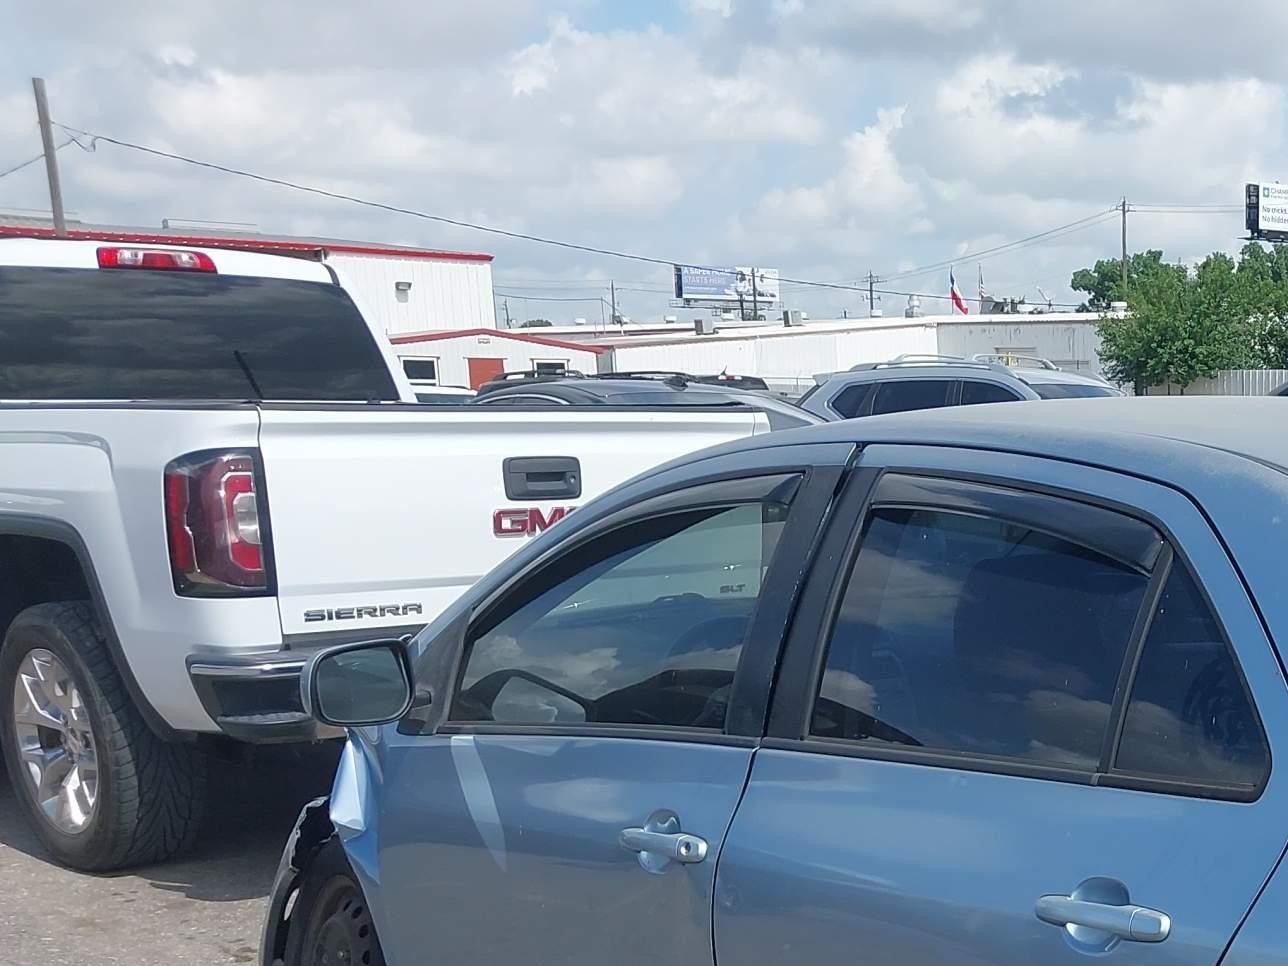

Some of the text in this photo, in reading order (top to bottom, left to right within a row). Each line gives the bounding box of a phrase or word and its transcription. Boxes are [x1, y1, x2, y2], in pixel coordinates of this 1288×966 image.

[1262, 205, 1271, 214] No
[1262, 215, 1271, 223] No
[493, 506, 577, 538] GM
[720, 584, 746, 593] SLT
[304, 602, 422, 622] SIERRA
